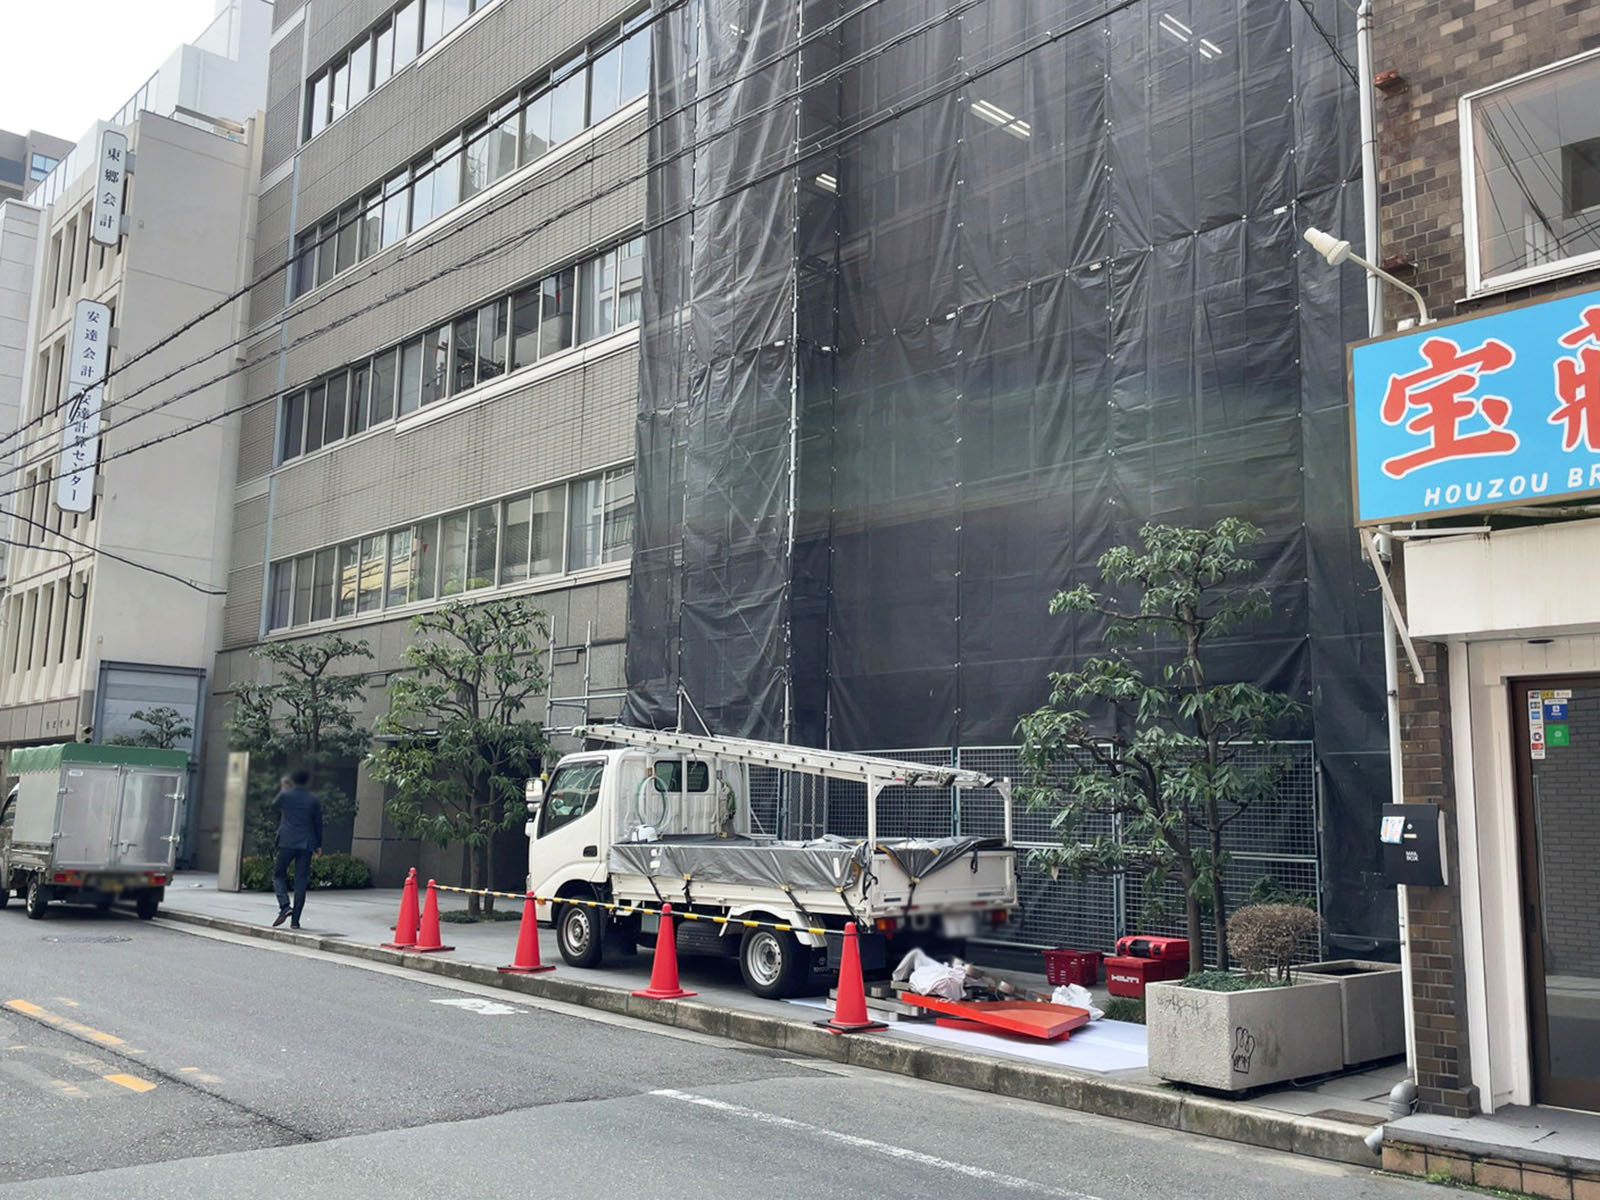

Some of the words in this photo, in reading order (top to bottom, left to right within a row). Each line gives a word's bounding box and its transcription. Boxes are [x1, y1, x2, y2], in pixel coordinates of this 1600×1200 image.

[99, 148, 121, 229] 東郷会計
[80, 310, 100, 378] 安達会計
[1424, 472, 1549, 507] HOUZOU
